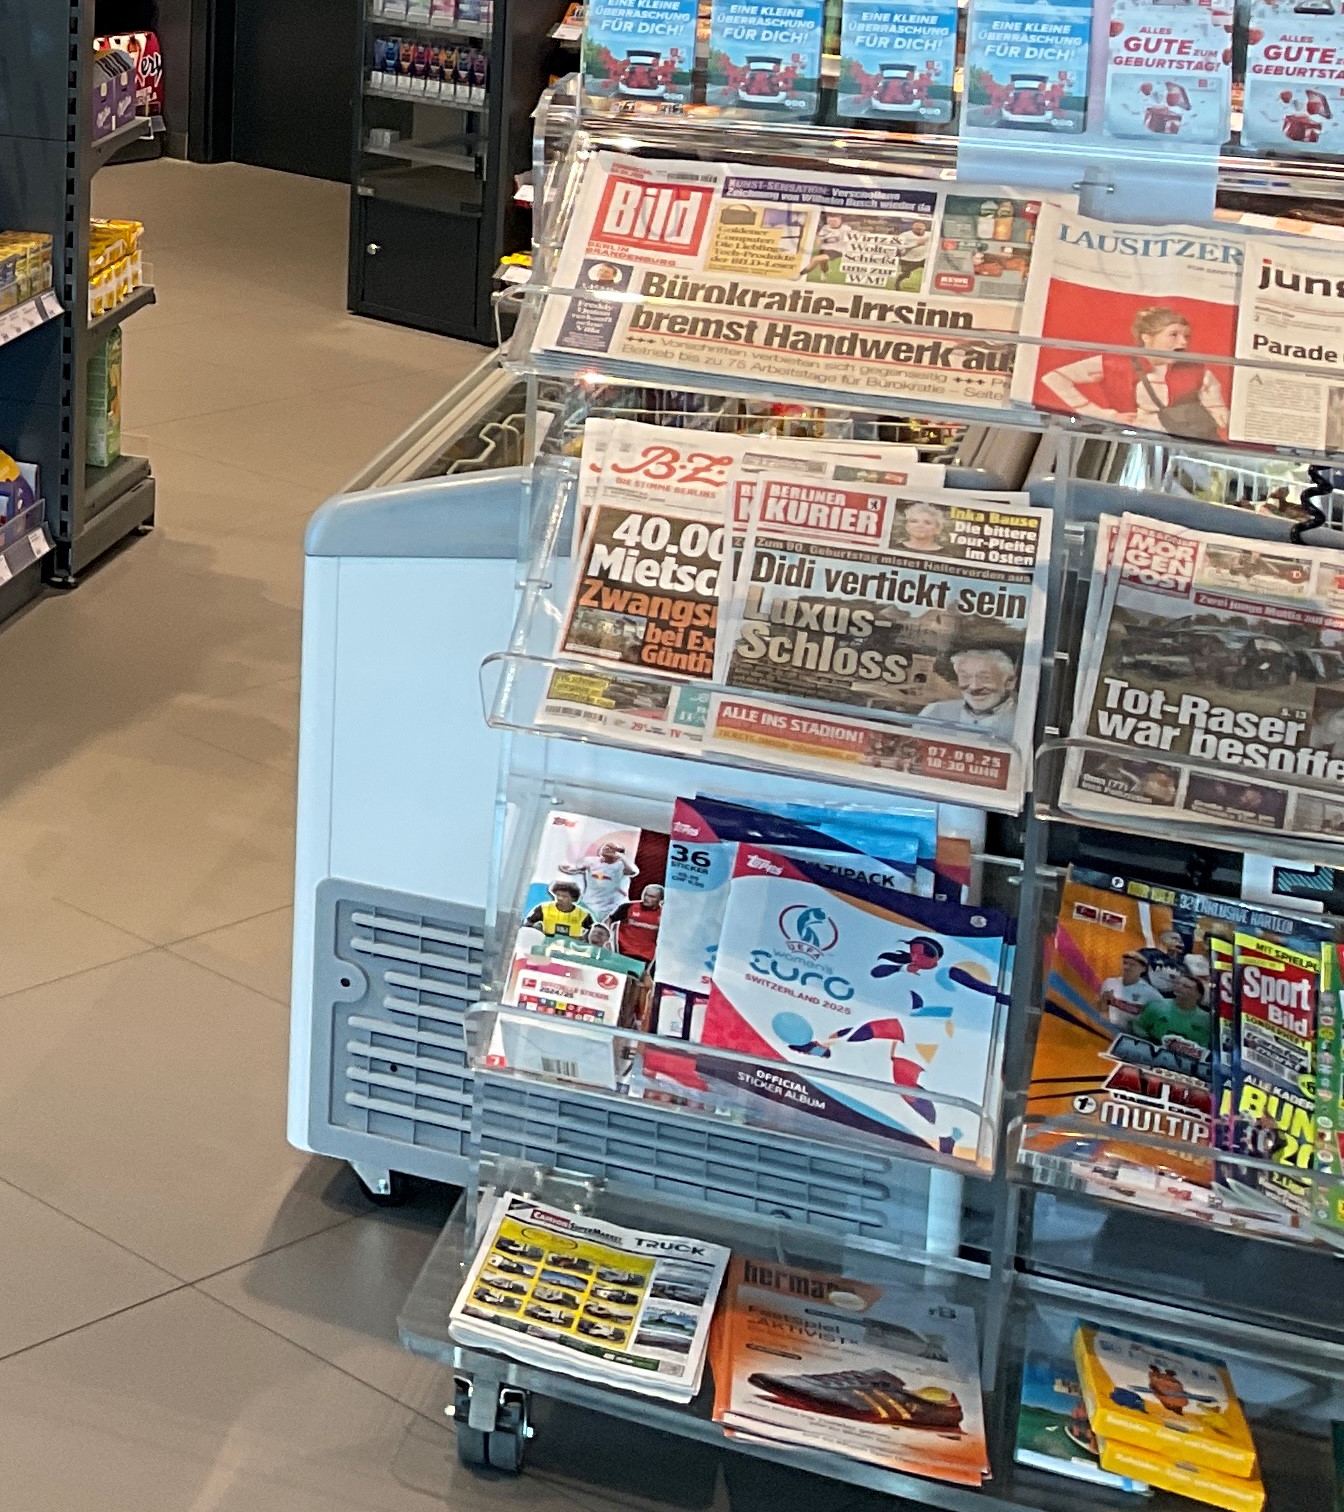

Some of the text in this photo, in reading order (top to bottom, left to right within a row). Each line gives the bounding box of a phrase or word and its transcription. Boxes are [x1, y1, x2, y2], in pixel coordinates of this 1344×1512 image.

[595, 5, 690, 23] ÜBERRASCHUNG
[637, 0, 680, 11] KLEINE
[729, 3, 805, 19] EINE KLEINE
[600, 19, 685, 38] FÜR DICH!
[717, 13, 815, 30] ÜBERRASCHUNG
[848, 21, 949, 37] ÜBERRASCHUNG
[861, 11, 938, 25] EINE KLEINE
[992, 20, 1071, 35] EINE KLEINE
[723, 26, 809, 45] FÜR DICH!
[979, 30, 1083, 47] ÜBERRASCHUNG
[1139, 26, 1172, 35] ALLES
[1280, 34, 1315, 44] ALLES
[854, 34, 943, 53] FÜR DICH!
[984, 44, 1076, 62] FÜR DICH!
[1124, 36, 1218, 58] GUTE ZUM
[1263, 44, 1337, 65] GUTE
[1113, 55, 1220, 73] GEBURTSTAG!
[1252, 63, 1344, 81] GEBURTSTA
[602, 181, 703, 245] Bild
[588, 242, 630, 252] BERLIN
[1059, 223, 1244, 267] LAUSITZER
[585, 248, 676, 267] BRANDENBURG
[849, 274, 885, 285] WM!
[643, 271, 973, 330] Bürokratie-Irrsinn
[630, 305, 757, 344] bremst
[764, 321, 953, 367] Handwerk
[1252, 333, 1336, 363] Parade
[769, 483, 846, 507] BERLINER
[764, 497, 879, 536] KURIER
[950, 506, 1039, 528] Inka Bause
[611, 513, 726, 563] 40.00
[954, 520, 1037, 540] Die bittere
[756, 540, 784, 550] Zum
[948, 532, 1035, 554] Tour-Pleite
[1130, 534, 1195, 561] MOR
[965, 548, 1034, 566] im Osten
[1126, 549, 1193, 576] GEN
[586, 543, 718, 598] Mietsc
[1121, 562, 1190, 592] POST
[750, 551, 1027, 620] Didi vertickt sein
[578, 577, 717, 629] Zwangs
[742, 581, 894, 638] Luxus-
[646, 621, 714, 651] bei Ex
[641, 645, 713, 675] Günth
[736, 621, 909, 685] Schloss
[1103, 677, 1305, 747] Tot-Raser
[721, 704, 866, 745] ALLE INS STADION!
[1097, 709, 1344, 782] war besoffe
[671, 844, 711, 868] 36
[671, 862, 709, 875] STICKER
[786, 941, 823, 960] UEFA
[745, 973, 852, 1015] SWITZERLAND 2025
[1243, 966, 1311, 1011] Sport
[1267, 1007, 1308, 1038] Bild
[736, 1069, 827, 1111] STICKER ALBUM
[755, 1068, 810, 1095] OFFICIAL
[1100, 1101, 1210, 1144] MULTIP
[1239, 1085, 1315, 1145] BUN
[635, 1237, 706, 1256] TRUCK
